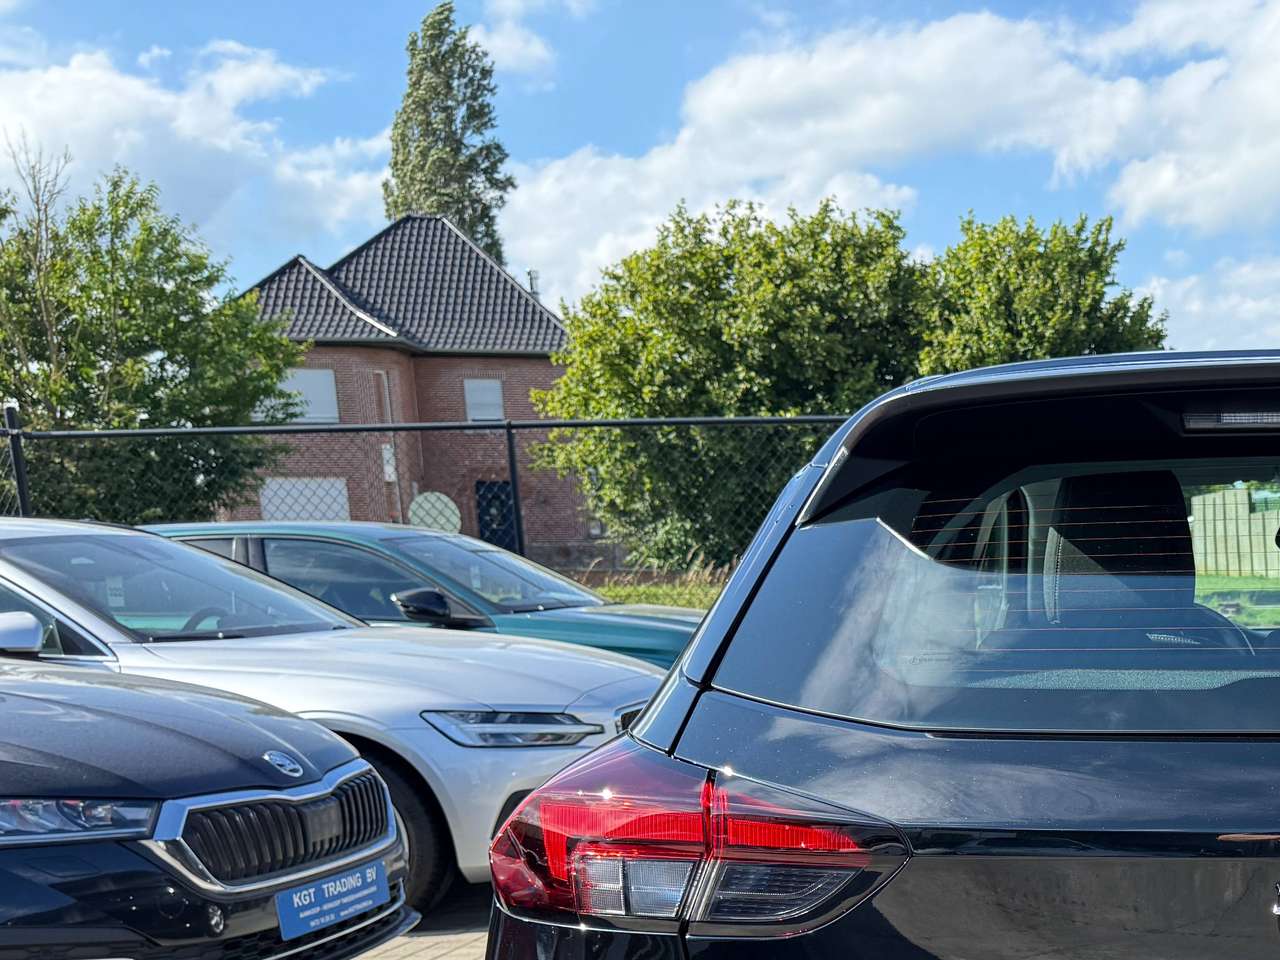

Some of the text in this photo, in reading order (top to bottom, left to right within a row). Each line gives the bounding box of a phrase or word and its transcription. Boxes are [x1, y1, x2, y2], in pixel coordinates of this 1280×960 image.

[293, 887, 315, 908] KGT
[323, 873, 362, 898] TRADING
[366, 866, 377, 883] BV
